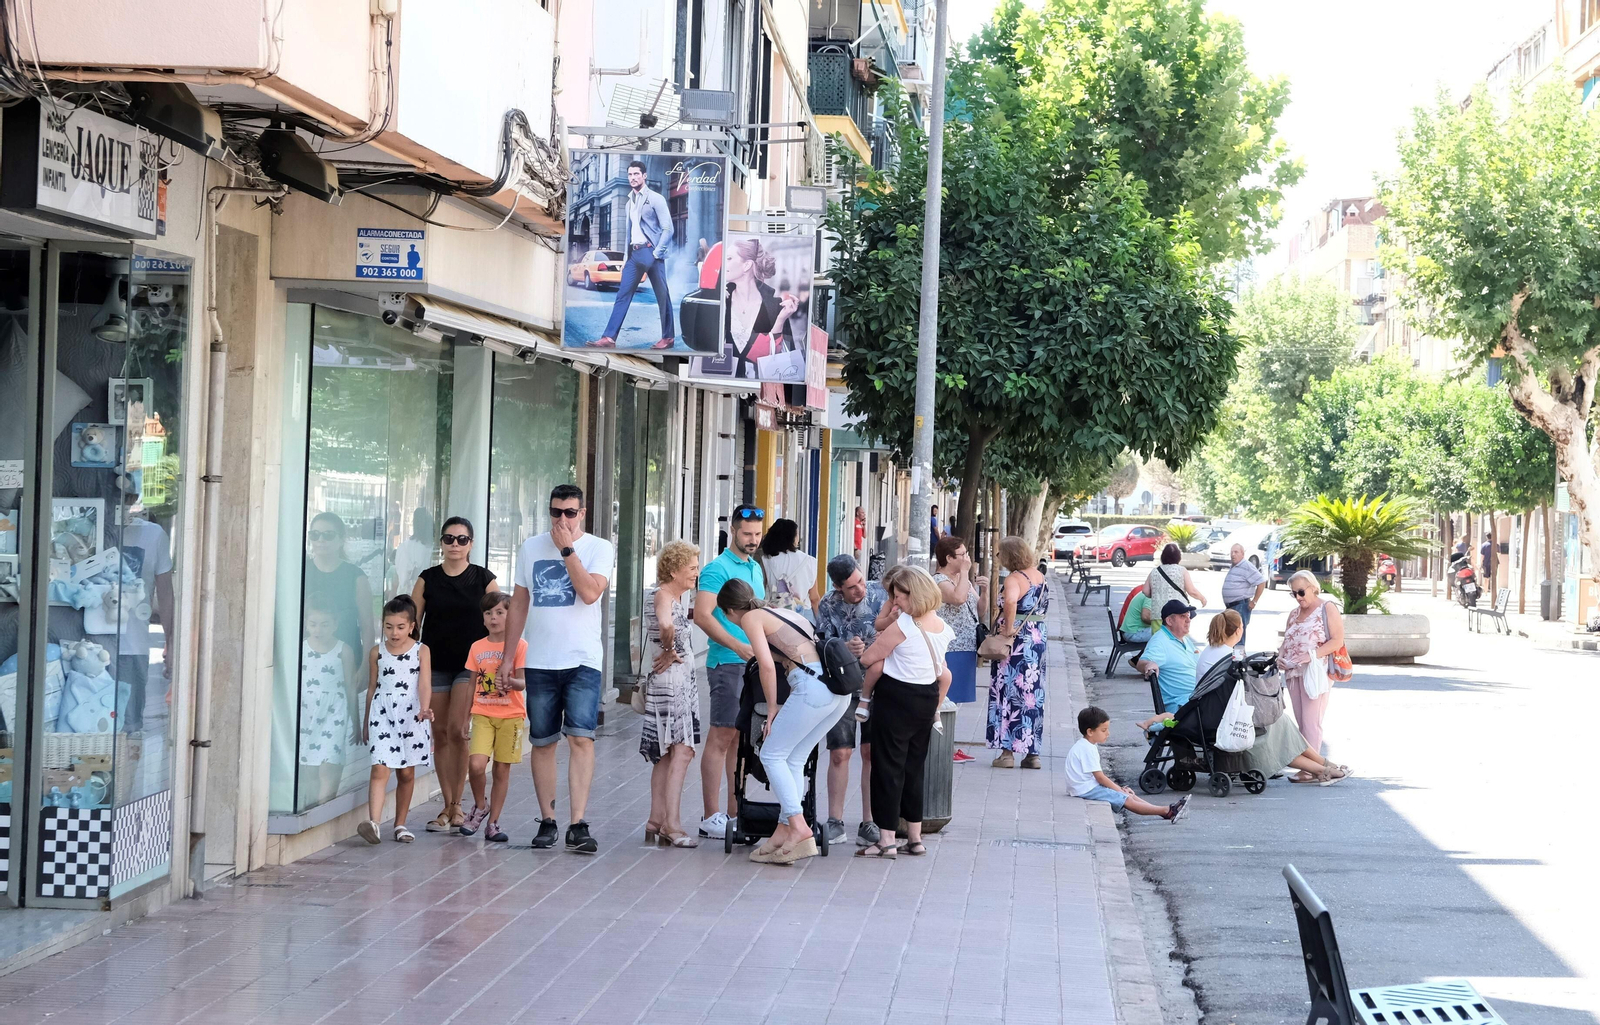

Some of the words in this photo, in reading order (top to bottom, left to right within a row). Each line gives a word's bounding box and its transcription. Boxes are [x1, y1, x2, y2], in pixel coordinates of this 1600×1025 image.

[42, 137, 69, 164] LENCERÍA
[70, 126, 131, 199] JAQUE
[42, 167, 67, 193] INFANTIL
[677, 161, 722, 192] Verdad
[359, 229, 423, 239] ALARMACONECTADA
[380, 244, 400, 253] SEGUR
[362, 267, 378, 276] 902
[381, 268, 397, 277] 365
[400, 269, 417, 278] 000
